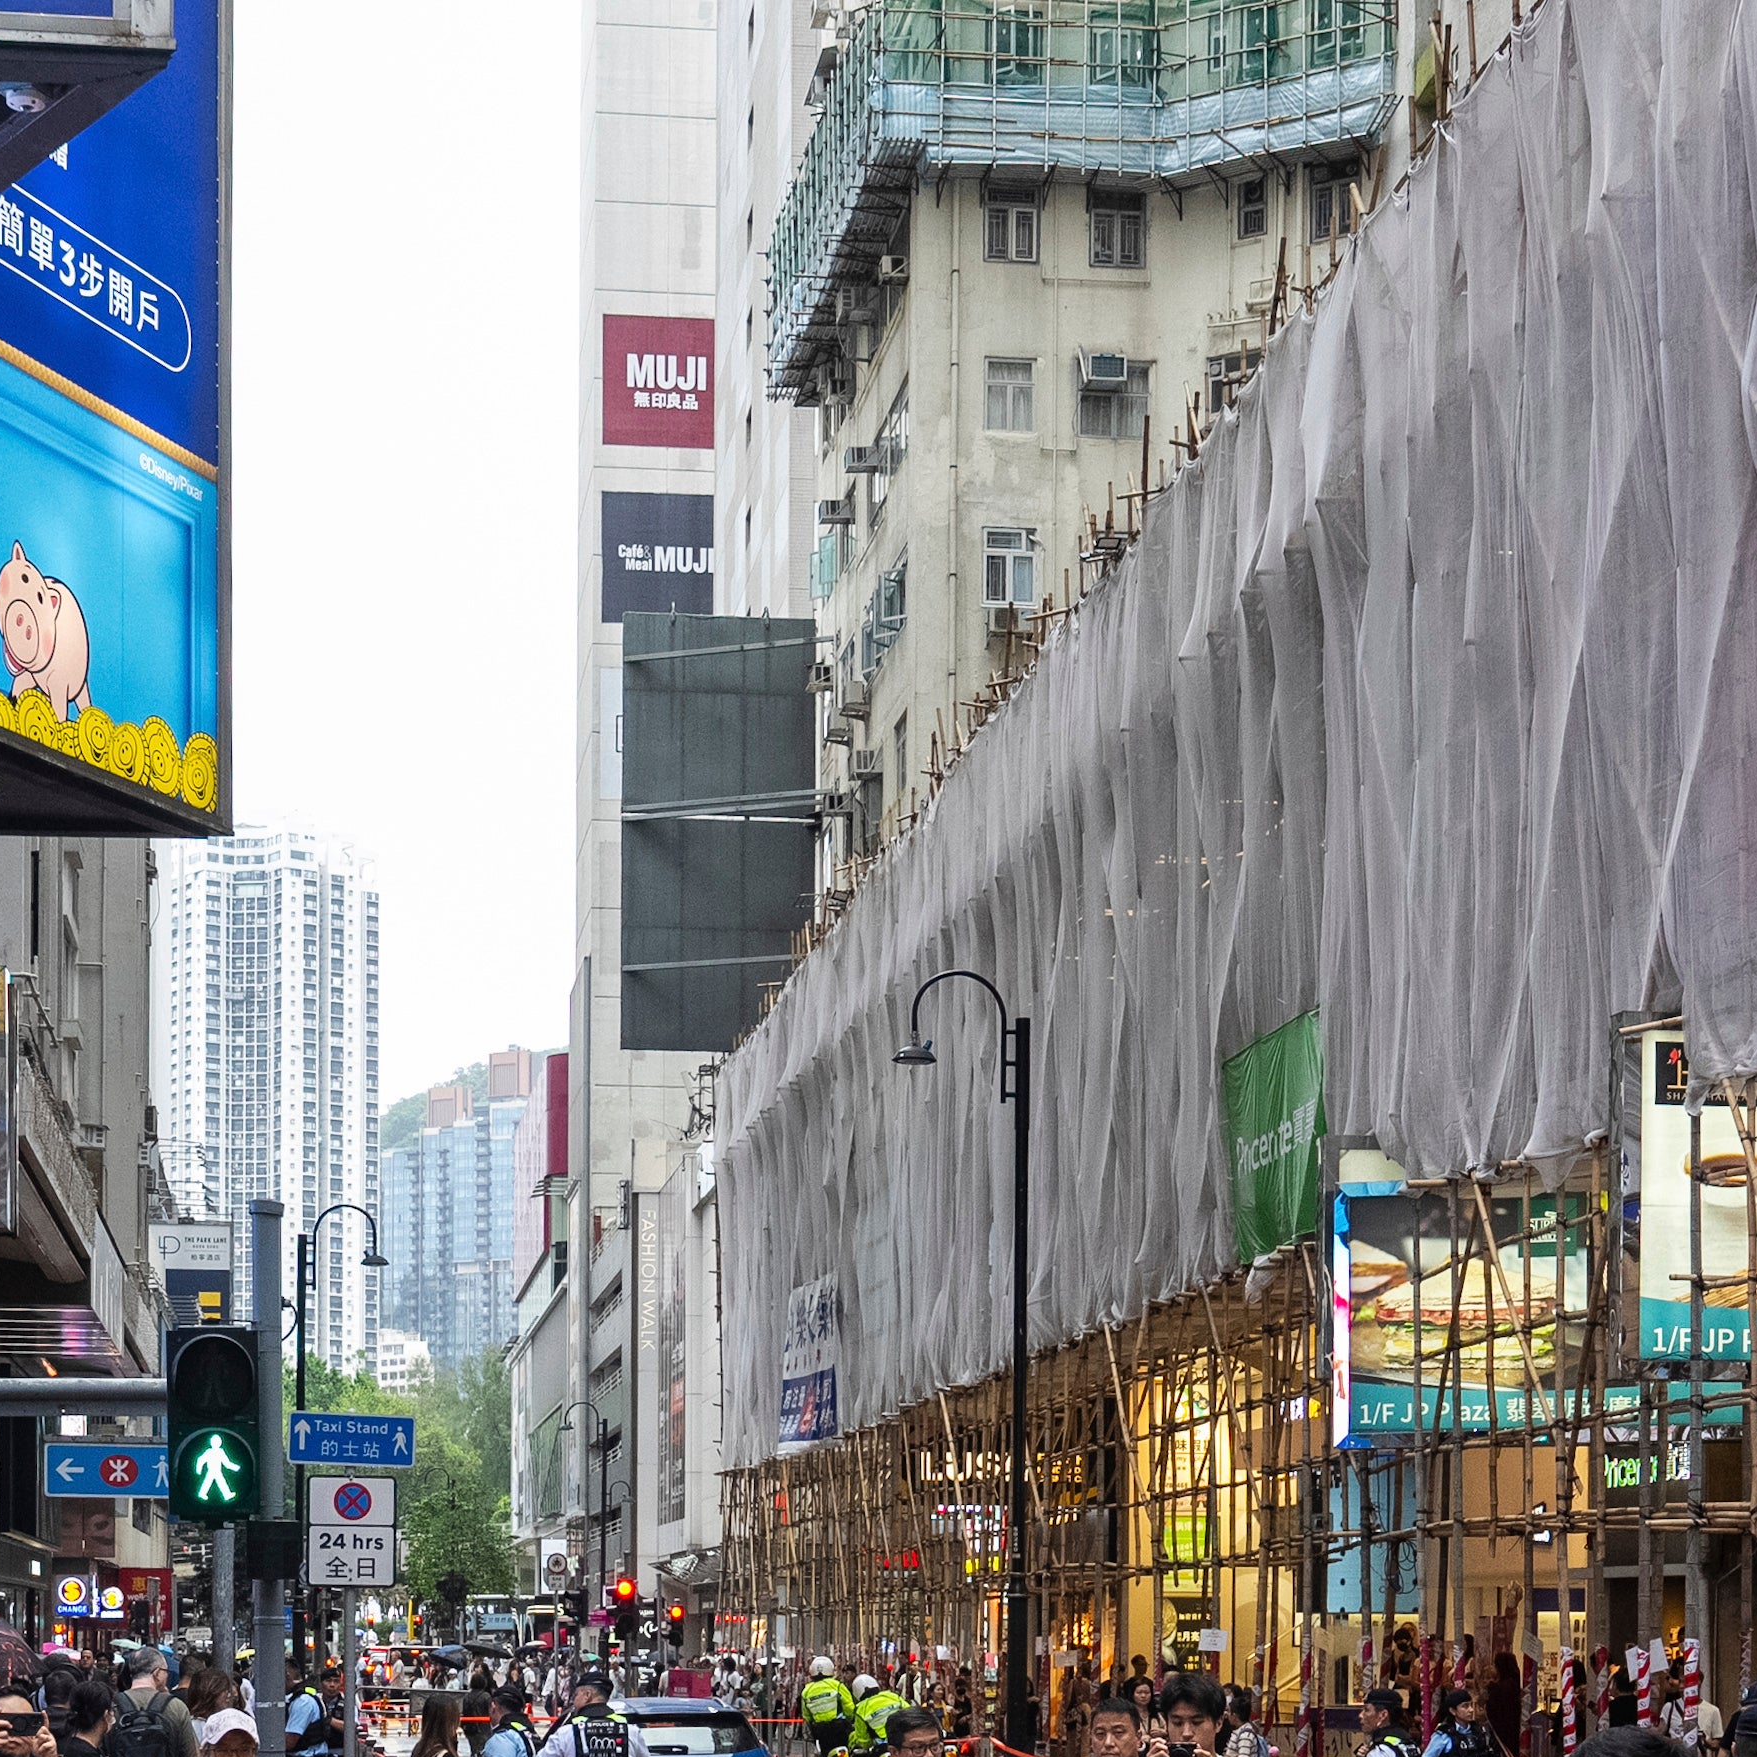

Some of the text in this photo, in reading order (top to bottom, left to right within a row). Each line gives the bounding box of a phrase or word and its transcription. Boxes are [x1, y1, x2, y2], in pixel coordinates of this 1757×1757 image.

[626, 353, 707, 392] MUJI
[633, 391, 699, 411] 無印良品
[655, 546, 714, 574] MUJI
[641, 1210, 657, 1350] FASHION WALK
[1359, 1403, 1395, 1425] 1/F
[314, 1419, 389, 1435] Taxi Stand
[321, 1439, 381, 1459] 的士站
[319, 1532, 384, 1550] 24 hrs
[325, 1556, 376, 1579] 全日
[57, 1605, 88, 1614] CHANGE
